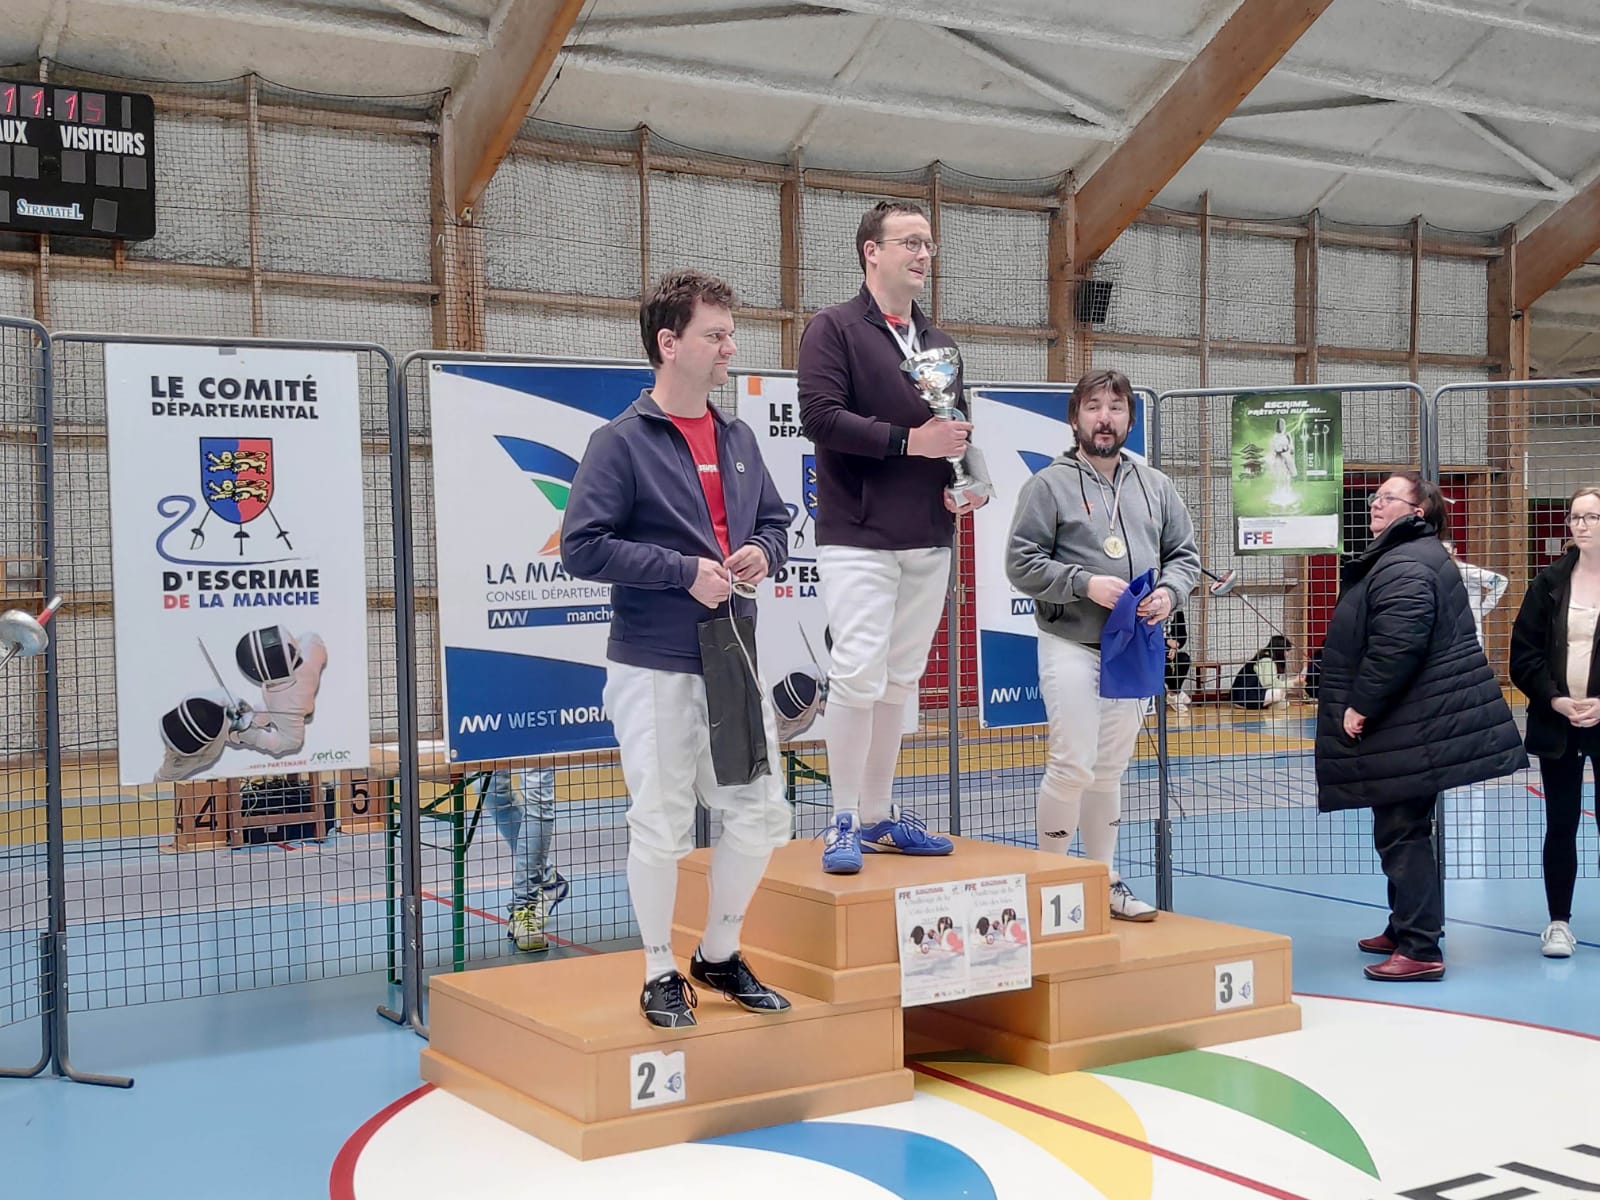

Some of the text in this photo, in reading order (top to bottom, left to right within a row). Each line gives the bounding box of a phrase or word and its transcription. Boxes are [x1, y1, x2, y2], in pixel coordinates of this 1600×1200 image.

[60, 125, 145, 156] VISITEURS
[150, 374, 318, 402] LE COMITÉ
[151, 399, 319, 419] DÉPARTEMENTAL
[769, 403, 793, 422] LE
[1243, 531, 1273, 545] FFE
[162, 569, 320, 591] D'ESCRIME
[486, 563, 517, 585] LA
[163, 592, 320, 609] DE LA MANCHE
[486, 586, 610, 602] CONSEIL DÉPARTEME
[775, 585, 817, 598] DE LA
[508, 710, 556, 729] WEST
[352, 779, 368, 815] 5
[195, 795, 218, 831] 4
[1050, 895, 1061, 927] 1
[1219, 972, 1233, 1003] 3
[637, 1061, 656, 1101] 2
